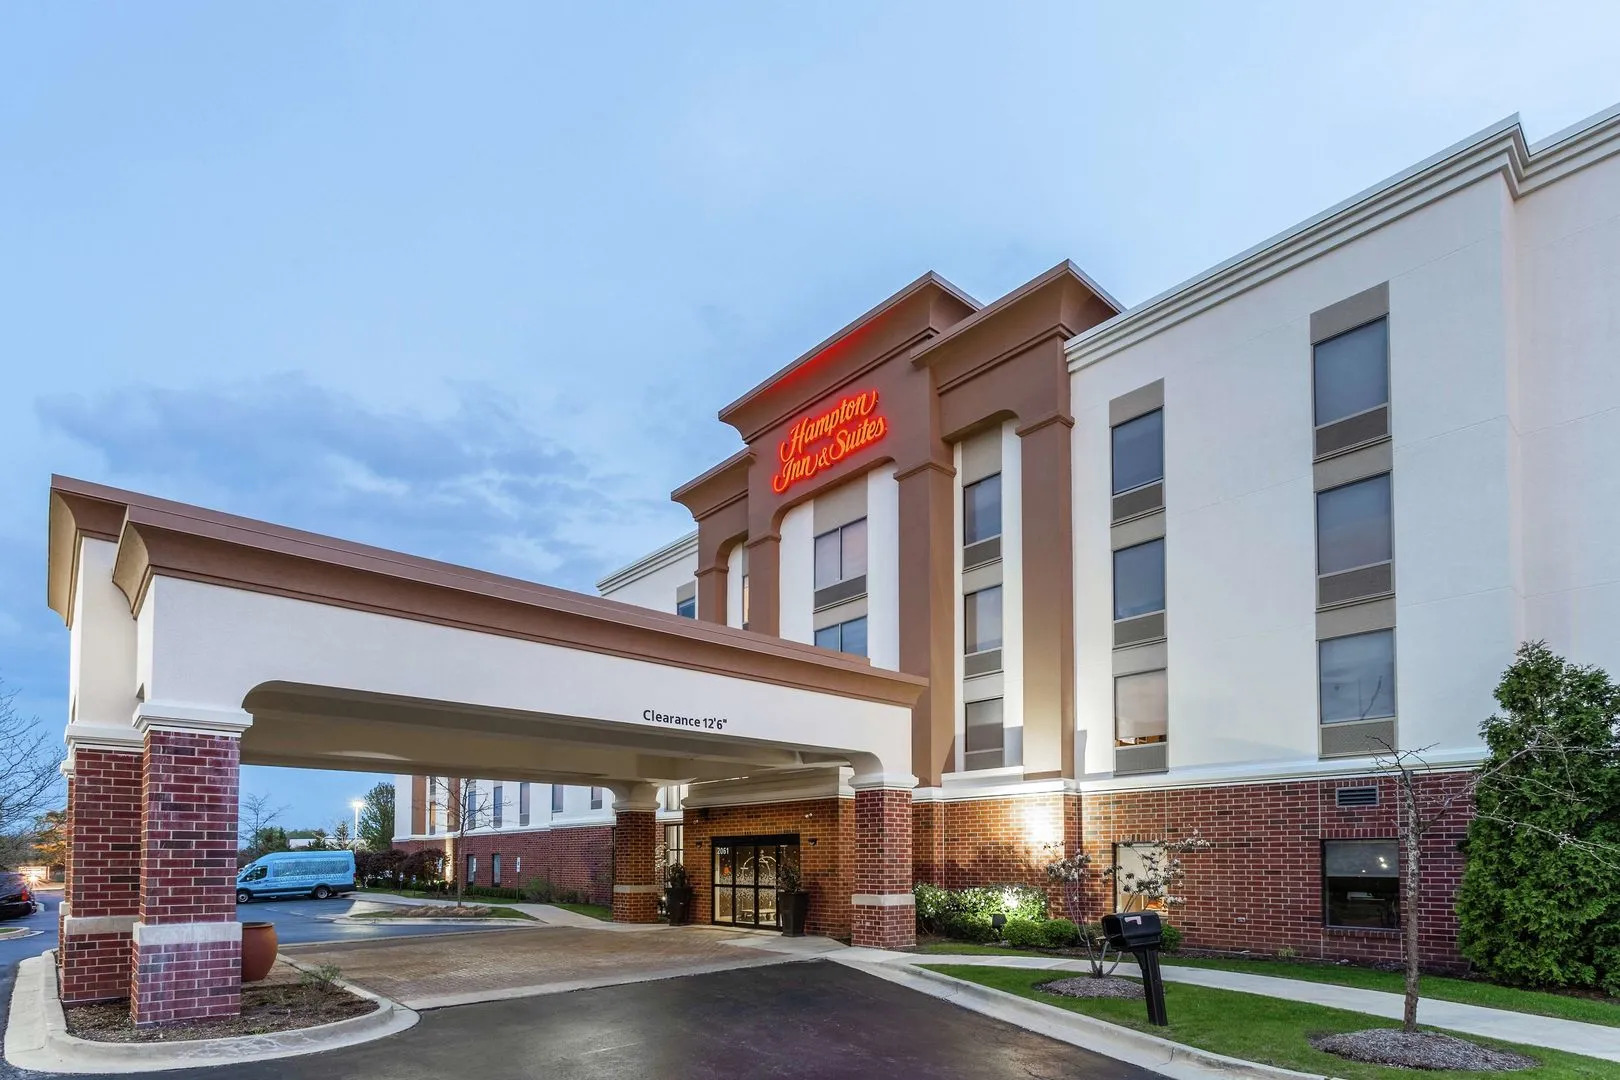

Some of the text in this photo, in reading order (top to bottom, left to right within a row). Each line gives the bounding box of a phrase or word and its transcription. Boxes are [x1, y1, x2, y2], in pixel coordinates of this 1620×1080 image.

[773, 453, 819, 493] Inn
[829, 416, 885, 461] Suites
[780, 389, 878, 463] Hampton
[643, 709, 727, 730] Clearance 12'6"
